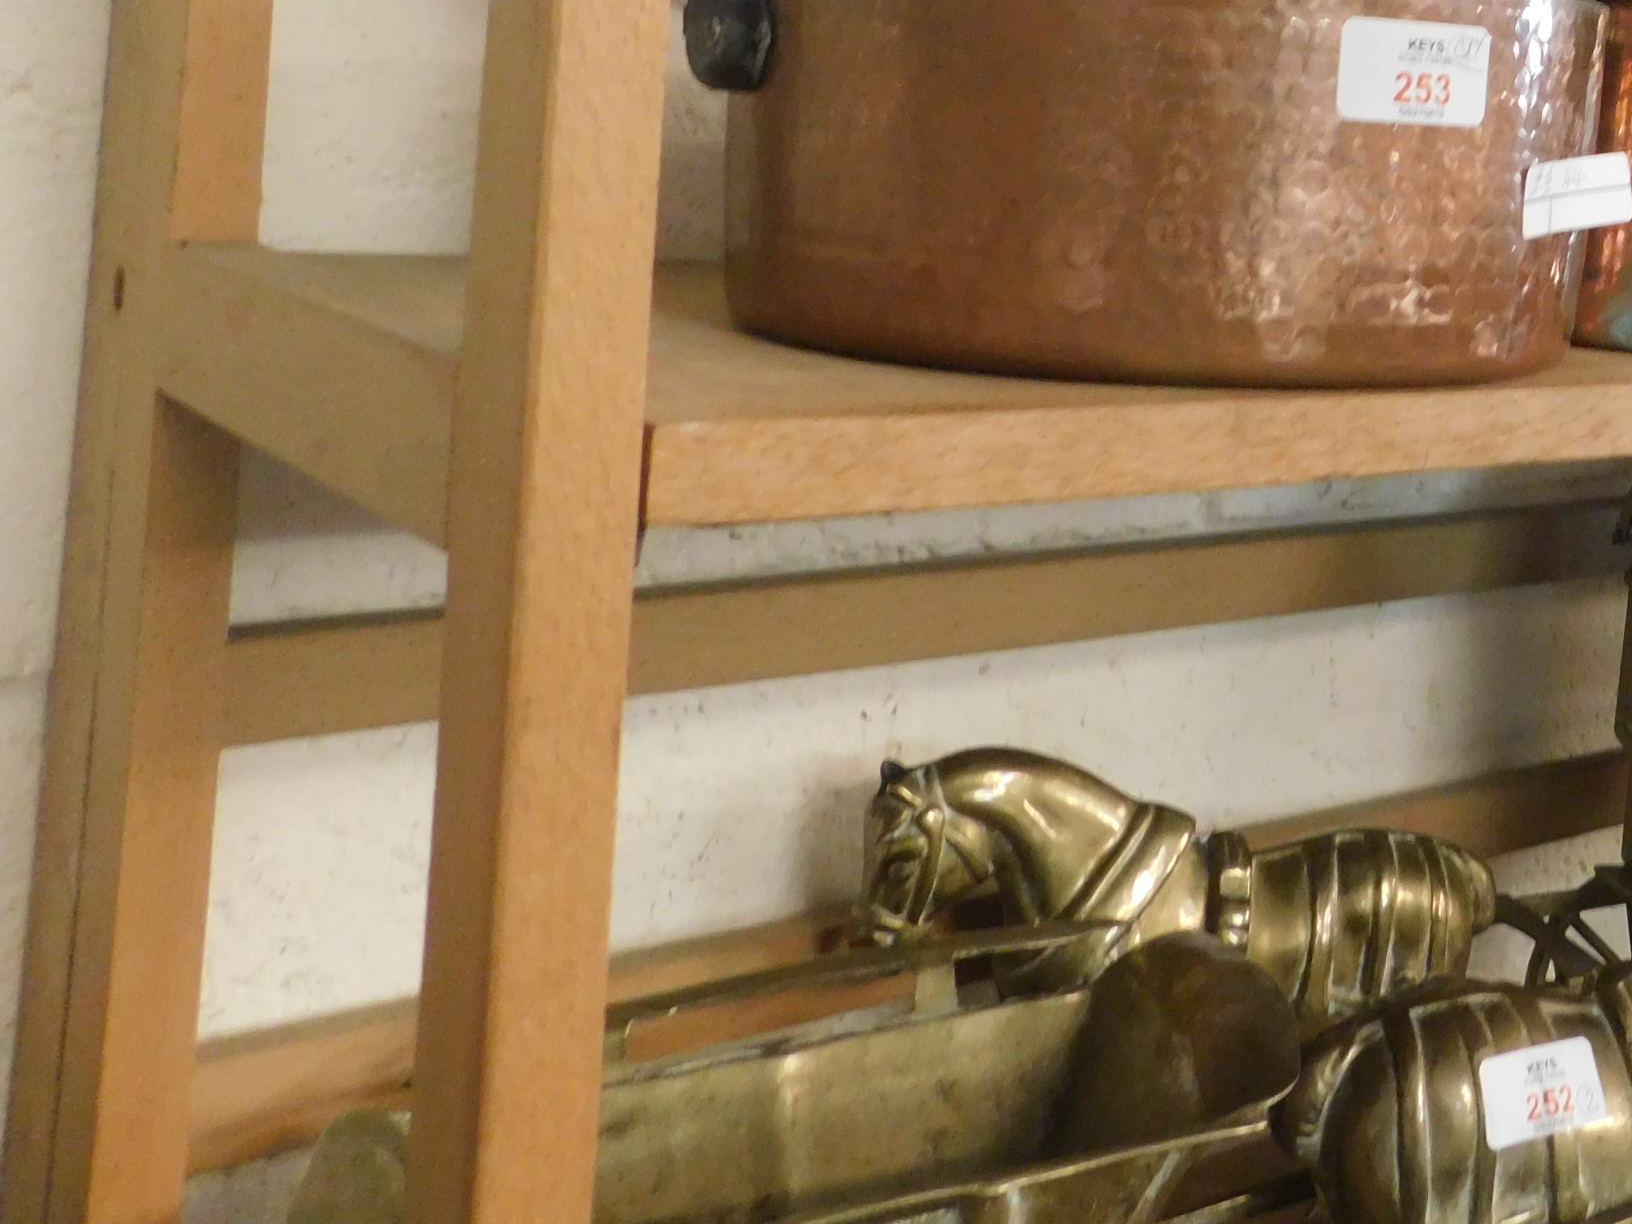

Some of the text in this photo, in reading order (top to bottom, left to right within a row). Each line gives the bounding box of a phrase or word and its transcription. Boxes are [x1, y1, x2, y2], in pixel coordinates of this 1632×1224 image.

[1407, 36, 1446, 54] KEYS
[1392, 70, 1452, 106] 253
[1525, 1083, 1576, 1121] 252
